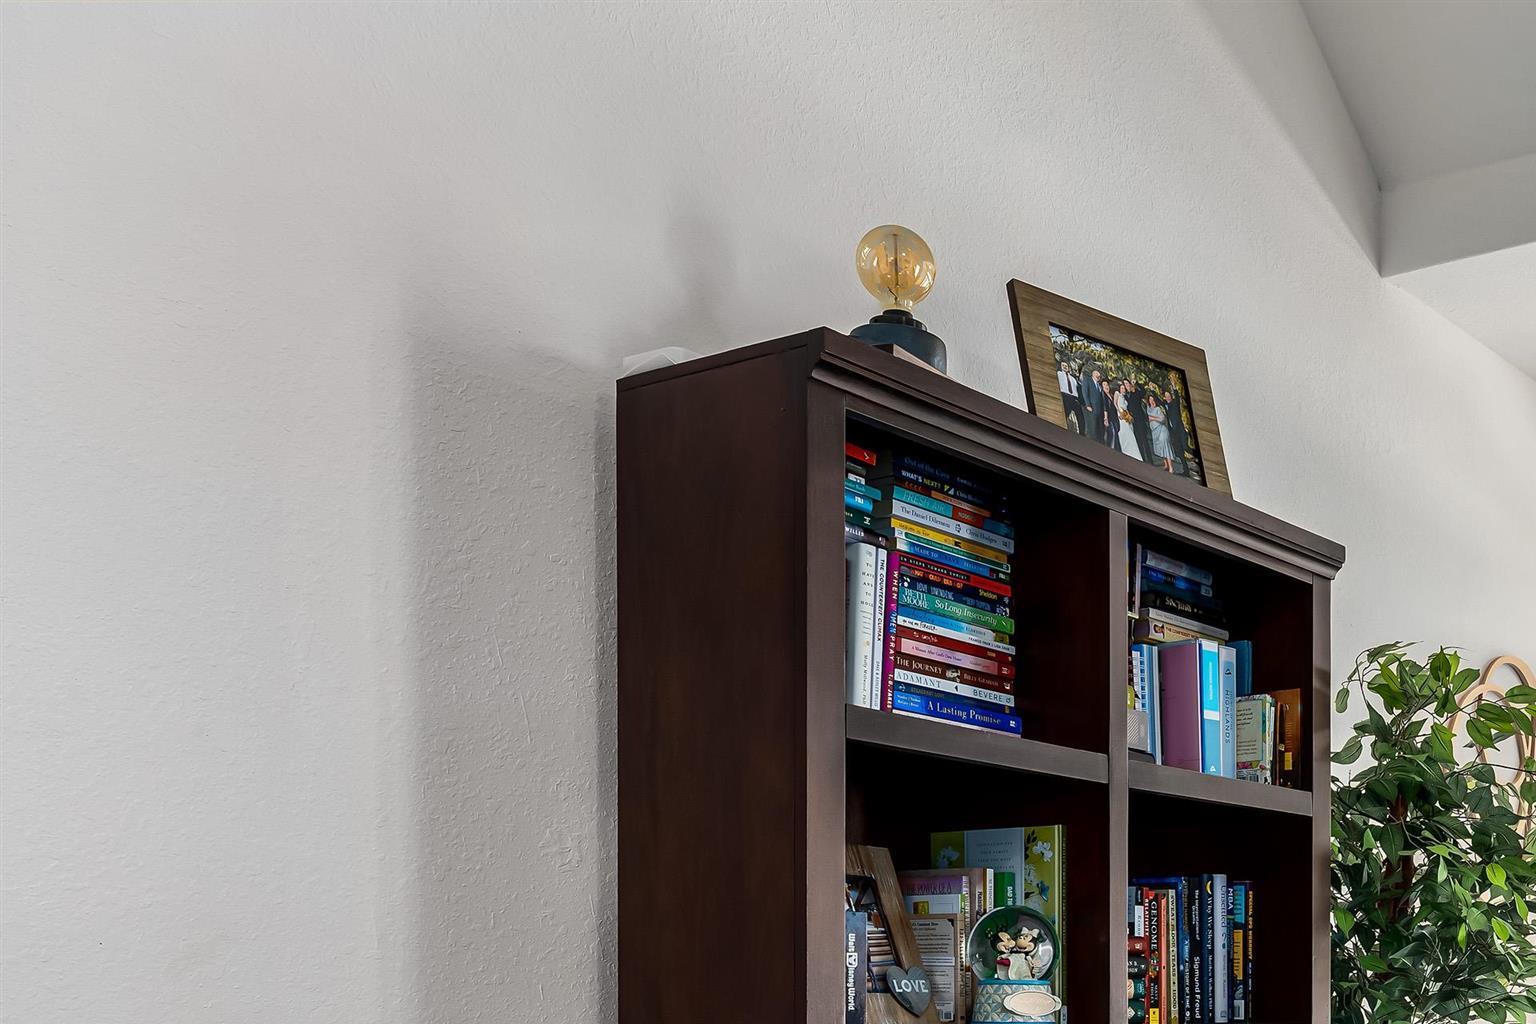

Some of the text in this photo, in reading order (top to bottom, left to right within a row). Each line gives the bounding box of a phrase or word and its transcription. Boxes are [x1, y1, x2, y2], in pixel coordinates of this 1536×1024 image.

[900, 506, 911, 516] The
[911, 509, 930, 521] Daniel
[901, 594, 931, 610] MOORE
[934, 599, 945, 612] So
[964, 608, 999, 626] Insecurity
[889, 603, 898, 633] WOMEN
[888, 635, 896, 661] PRAY
[896, 656, 910, 668] THE
[912, 660, 944, 675] JOURNEY
[896, 671, 1003, 704] ADAMANT BEVERE
[927, 700, 1001, 726] A Lasting Promise
[1150, 901, 1158, 950] GENOME
[1207, 916, 1213, 927] We
[846, 933, 857, 952] Walt
[1193, 956, 1201, 992] Sigmund
[892, 979, 929, 994] LOVE
[846, 988, 857, 1011] World
